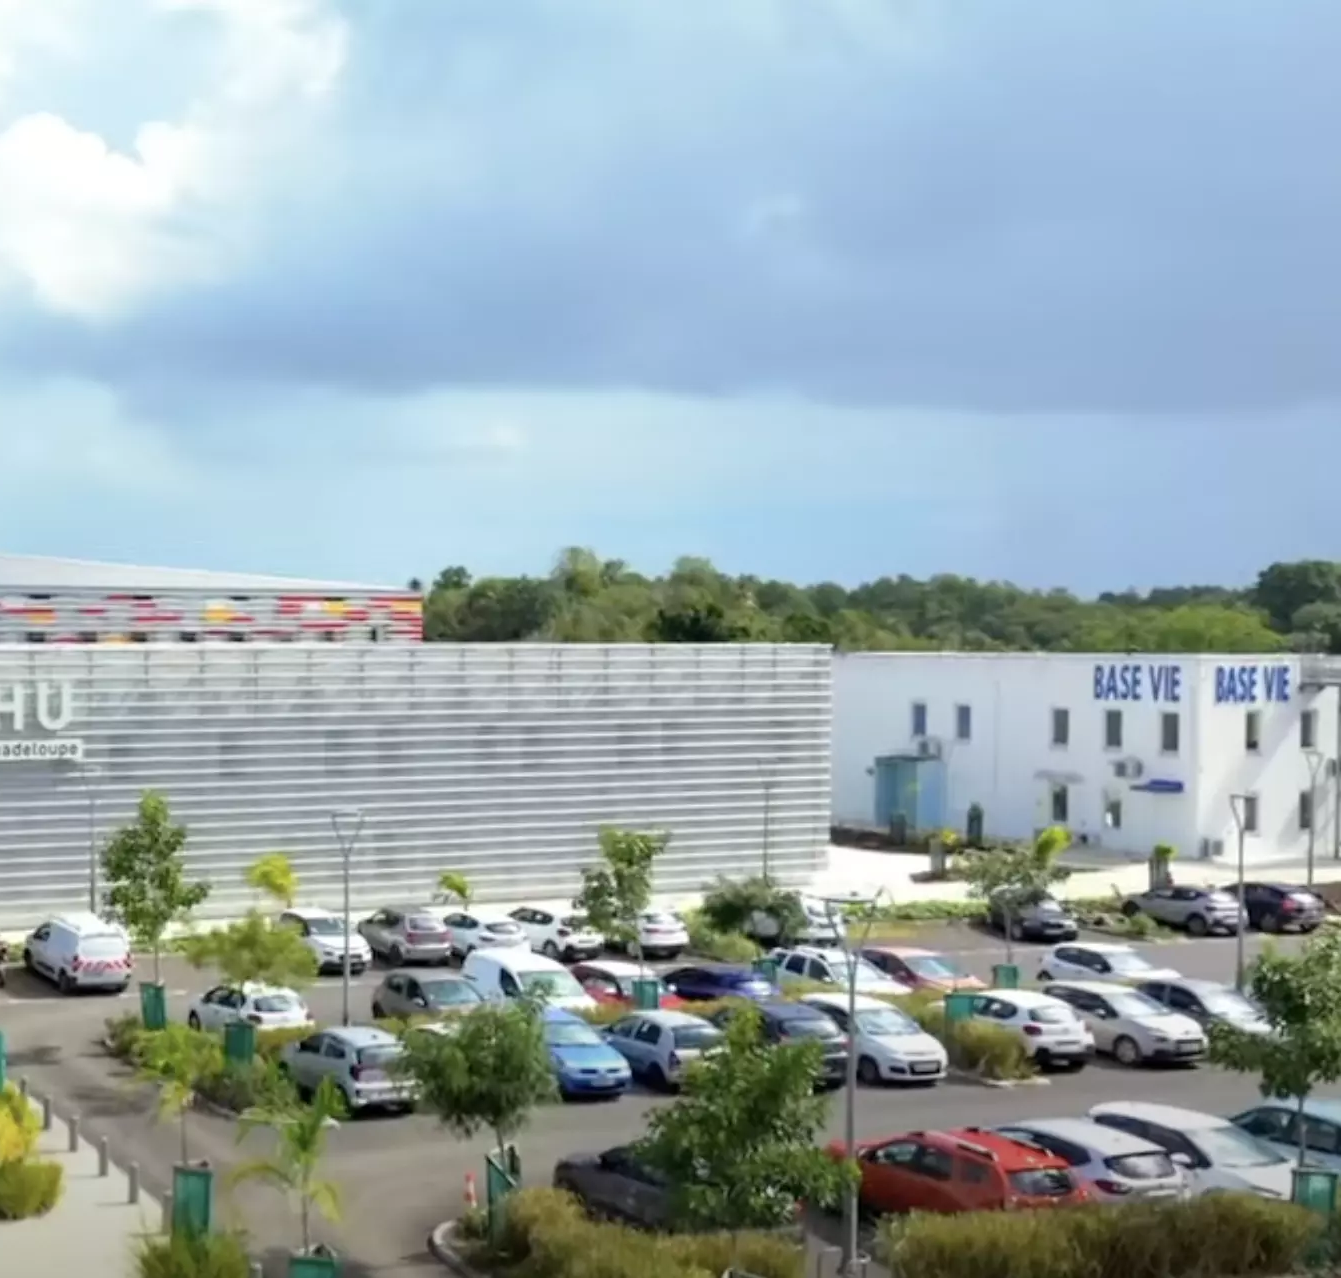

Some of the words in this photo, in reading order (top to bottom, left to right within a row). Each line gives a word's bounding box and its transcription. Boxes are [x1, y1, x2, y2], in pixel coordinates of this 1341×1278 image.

[1094, 664, 1142, 701] BASE
[1149, 664, 1181, 702] VIE
[1215, 665, 1258, 704] BASE
[1264, 664, 1290, 702] VIE
